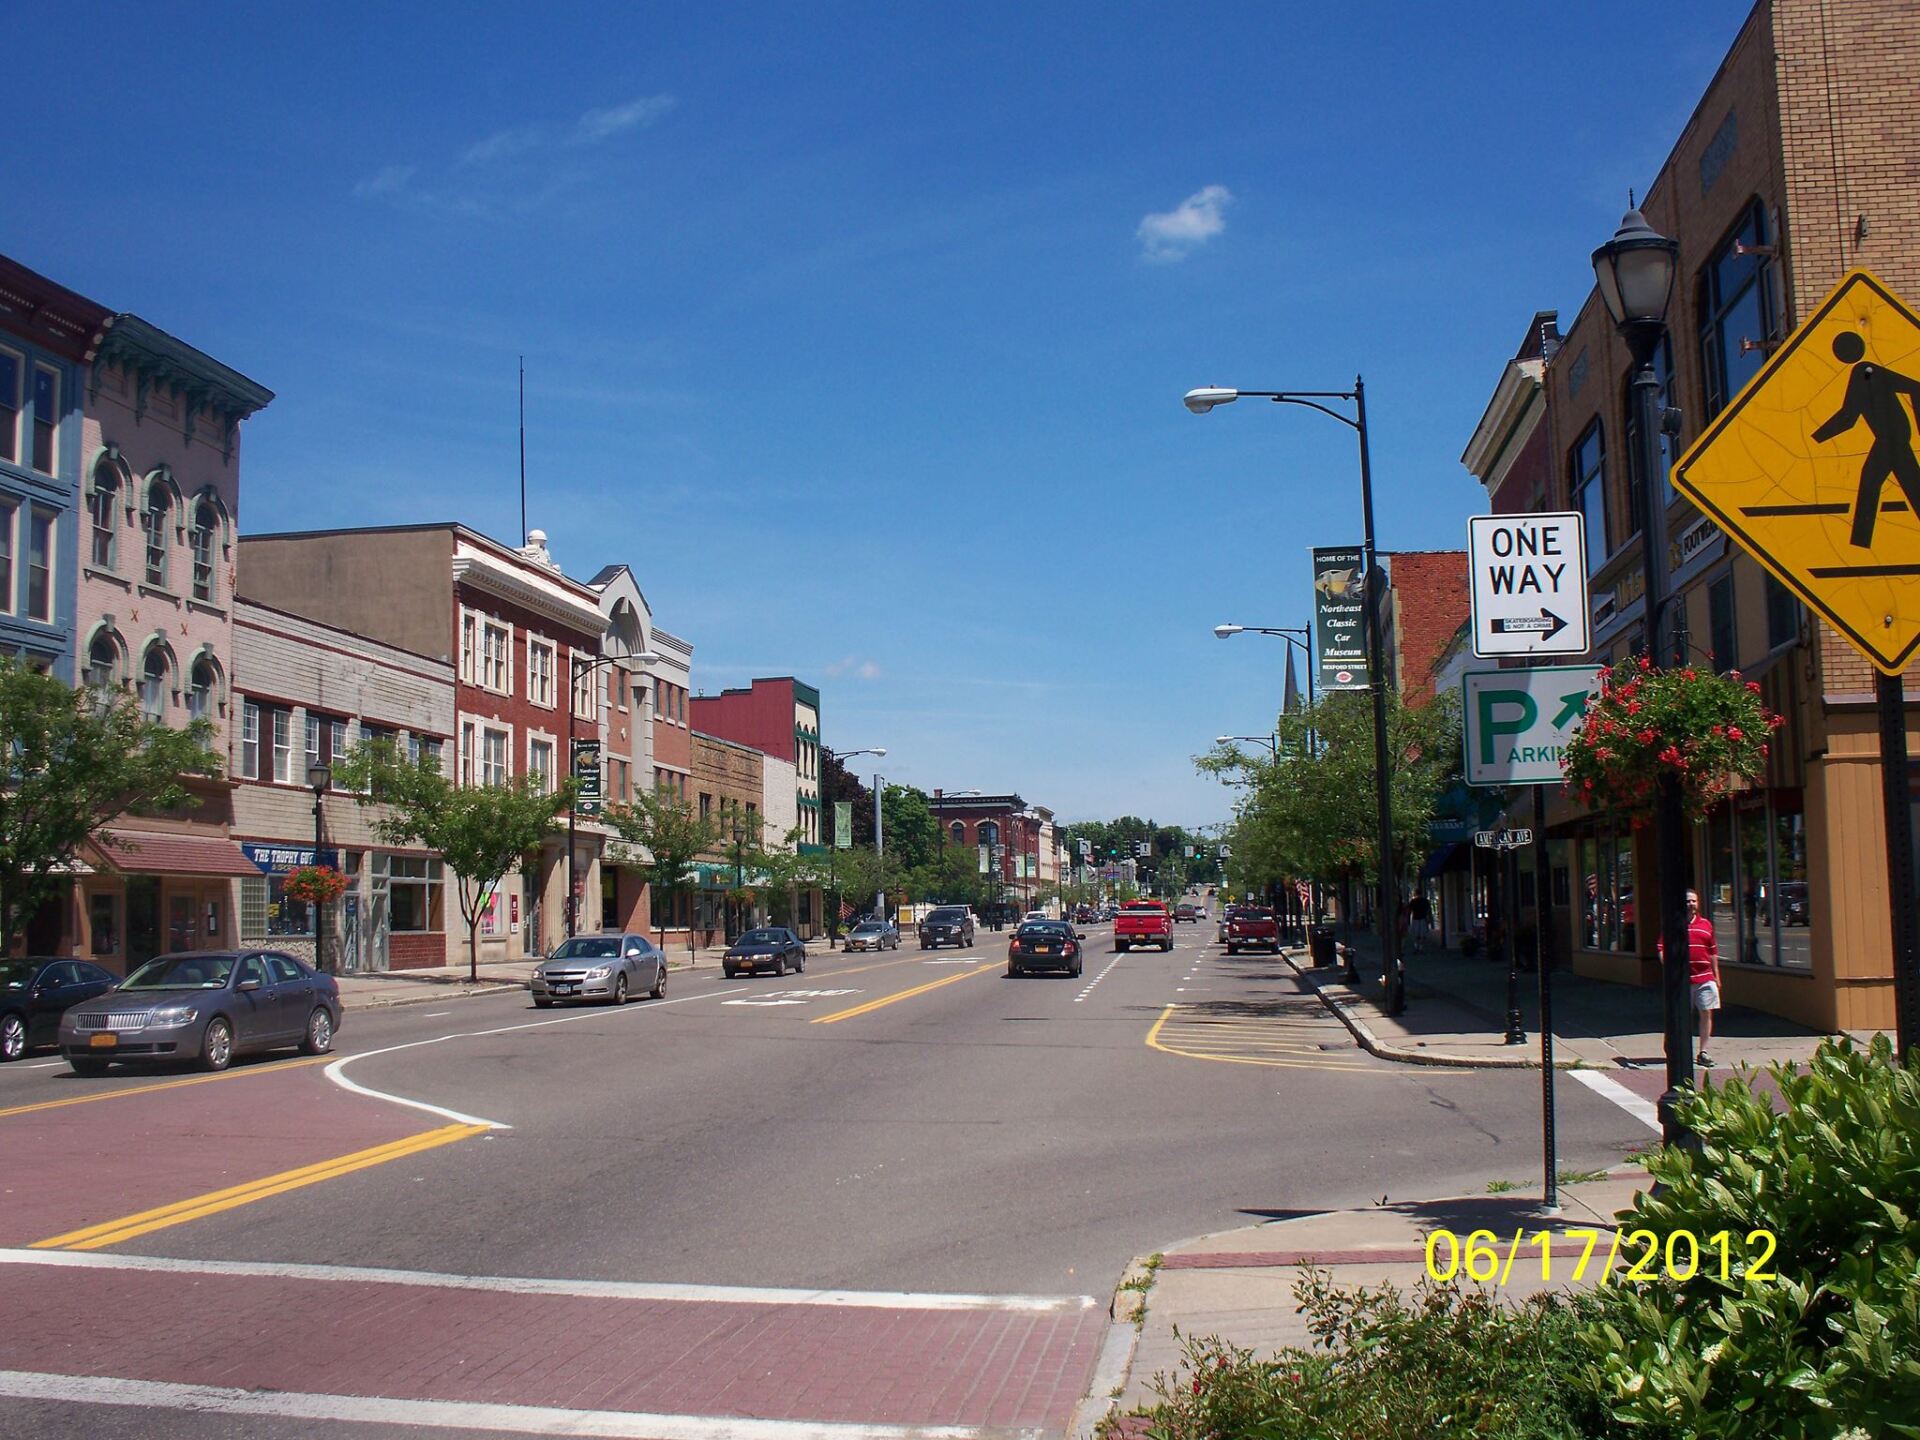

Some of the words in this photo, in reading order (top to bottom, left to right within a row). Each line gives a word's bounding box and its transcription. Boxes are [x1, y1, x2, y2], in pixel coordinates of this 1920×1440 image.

[1491, 526, 1562, 557] ONE
[1684, 519, 1718, 555] FOOTWEA
[1489, 563, 1566, 594] WAY
[1320, 605, 1362, 613] Northeast
[1327, 619, 1357, 627] Classic
[1325, 648, 1362, 656] Museum
[1478, 690, 1562, 764] PARKI
[1516, 830, 1530, 843] AVE
[254, 849, 270, 863] THE
[271, 850, 299, 864] TROPHY
